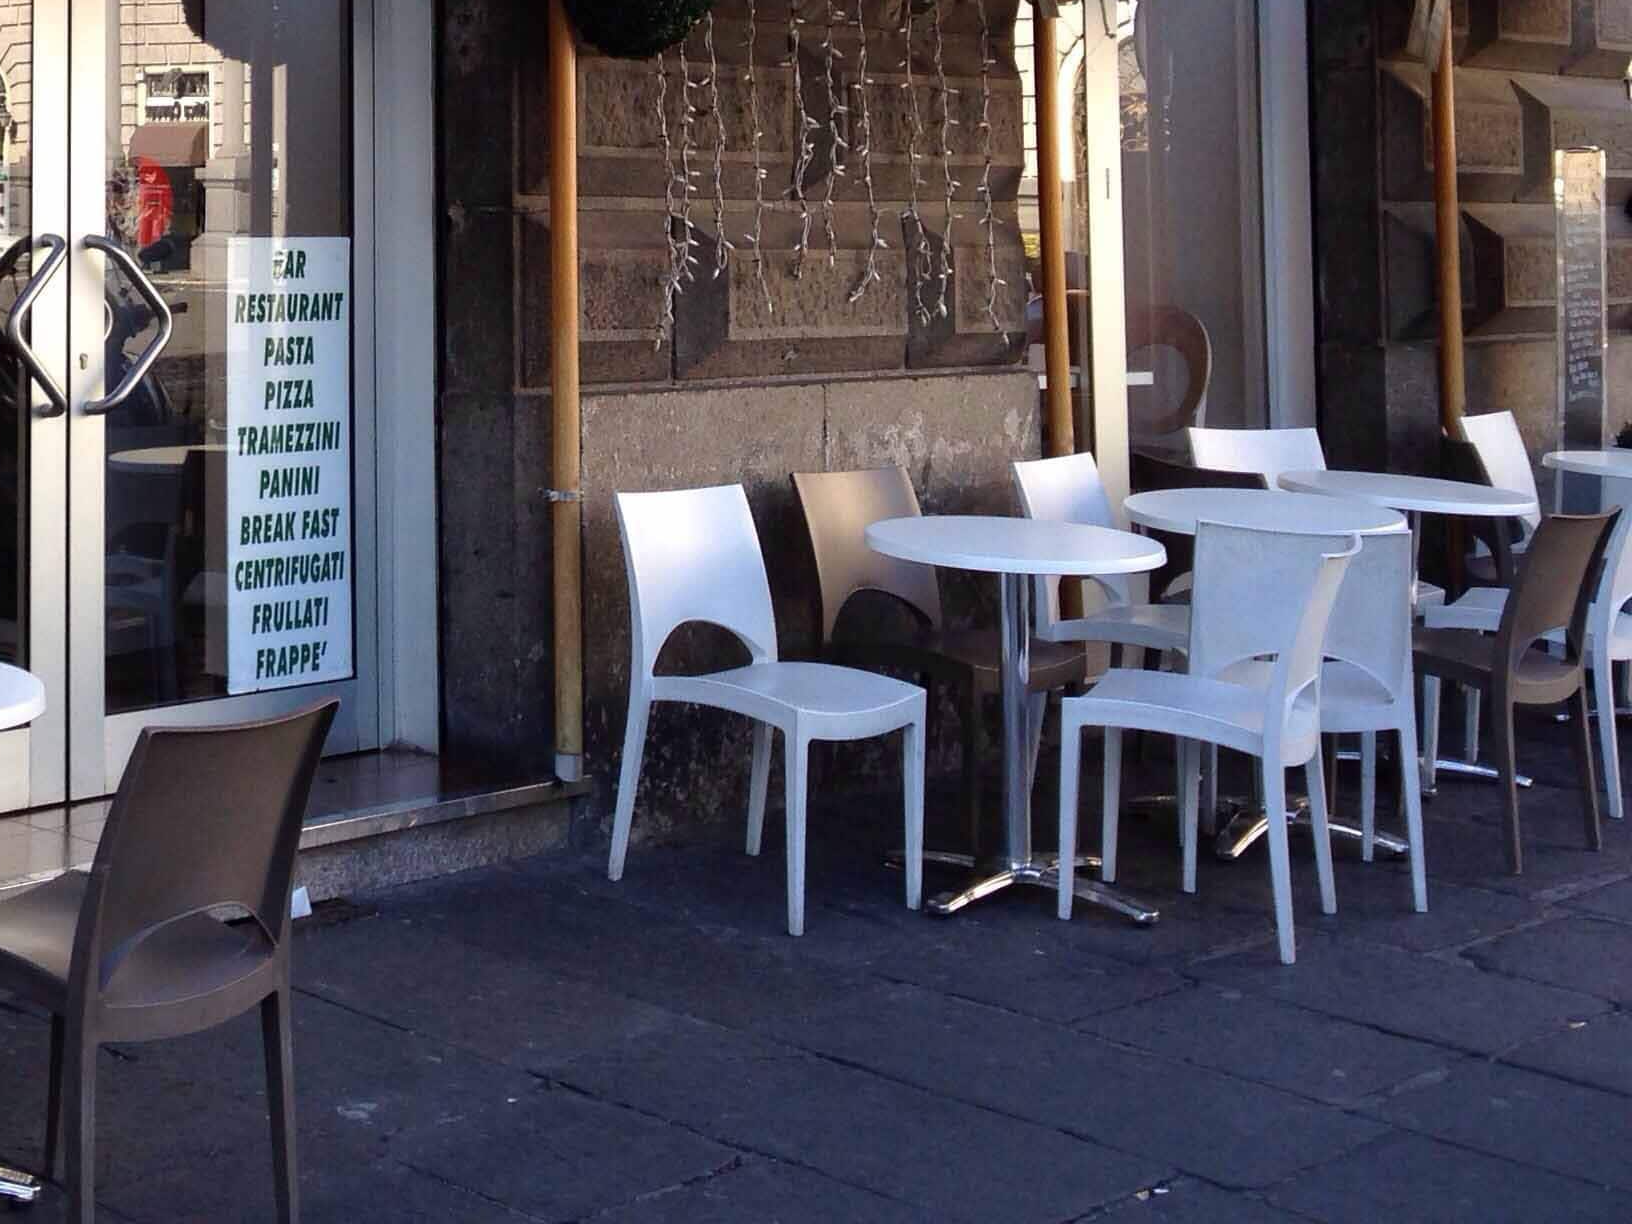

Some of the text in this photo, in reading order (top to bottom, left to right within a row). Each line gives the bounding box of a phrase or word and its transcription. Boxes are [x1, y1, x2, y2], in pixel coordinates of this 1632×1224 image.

[234, 292, 344, 324] RESTAURANT
[263, 336, 315, 367] PASTA
[263, 380, 315, 411] PIZZA
[237, 421, 341, 457] TRAMEZZINI
[258, 465, 320, 500] PANINI
[239, 507, 340, 546] BREAK FAST
[234, 550, 344, 592] CENTRIFUGATI
[251, 596, 329, 636] FRULLATI
